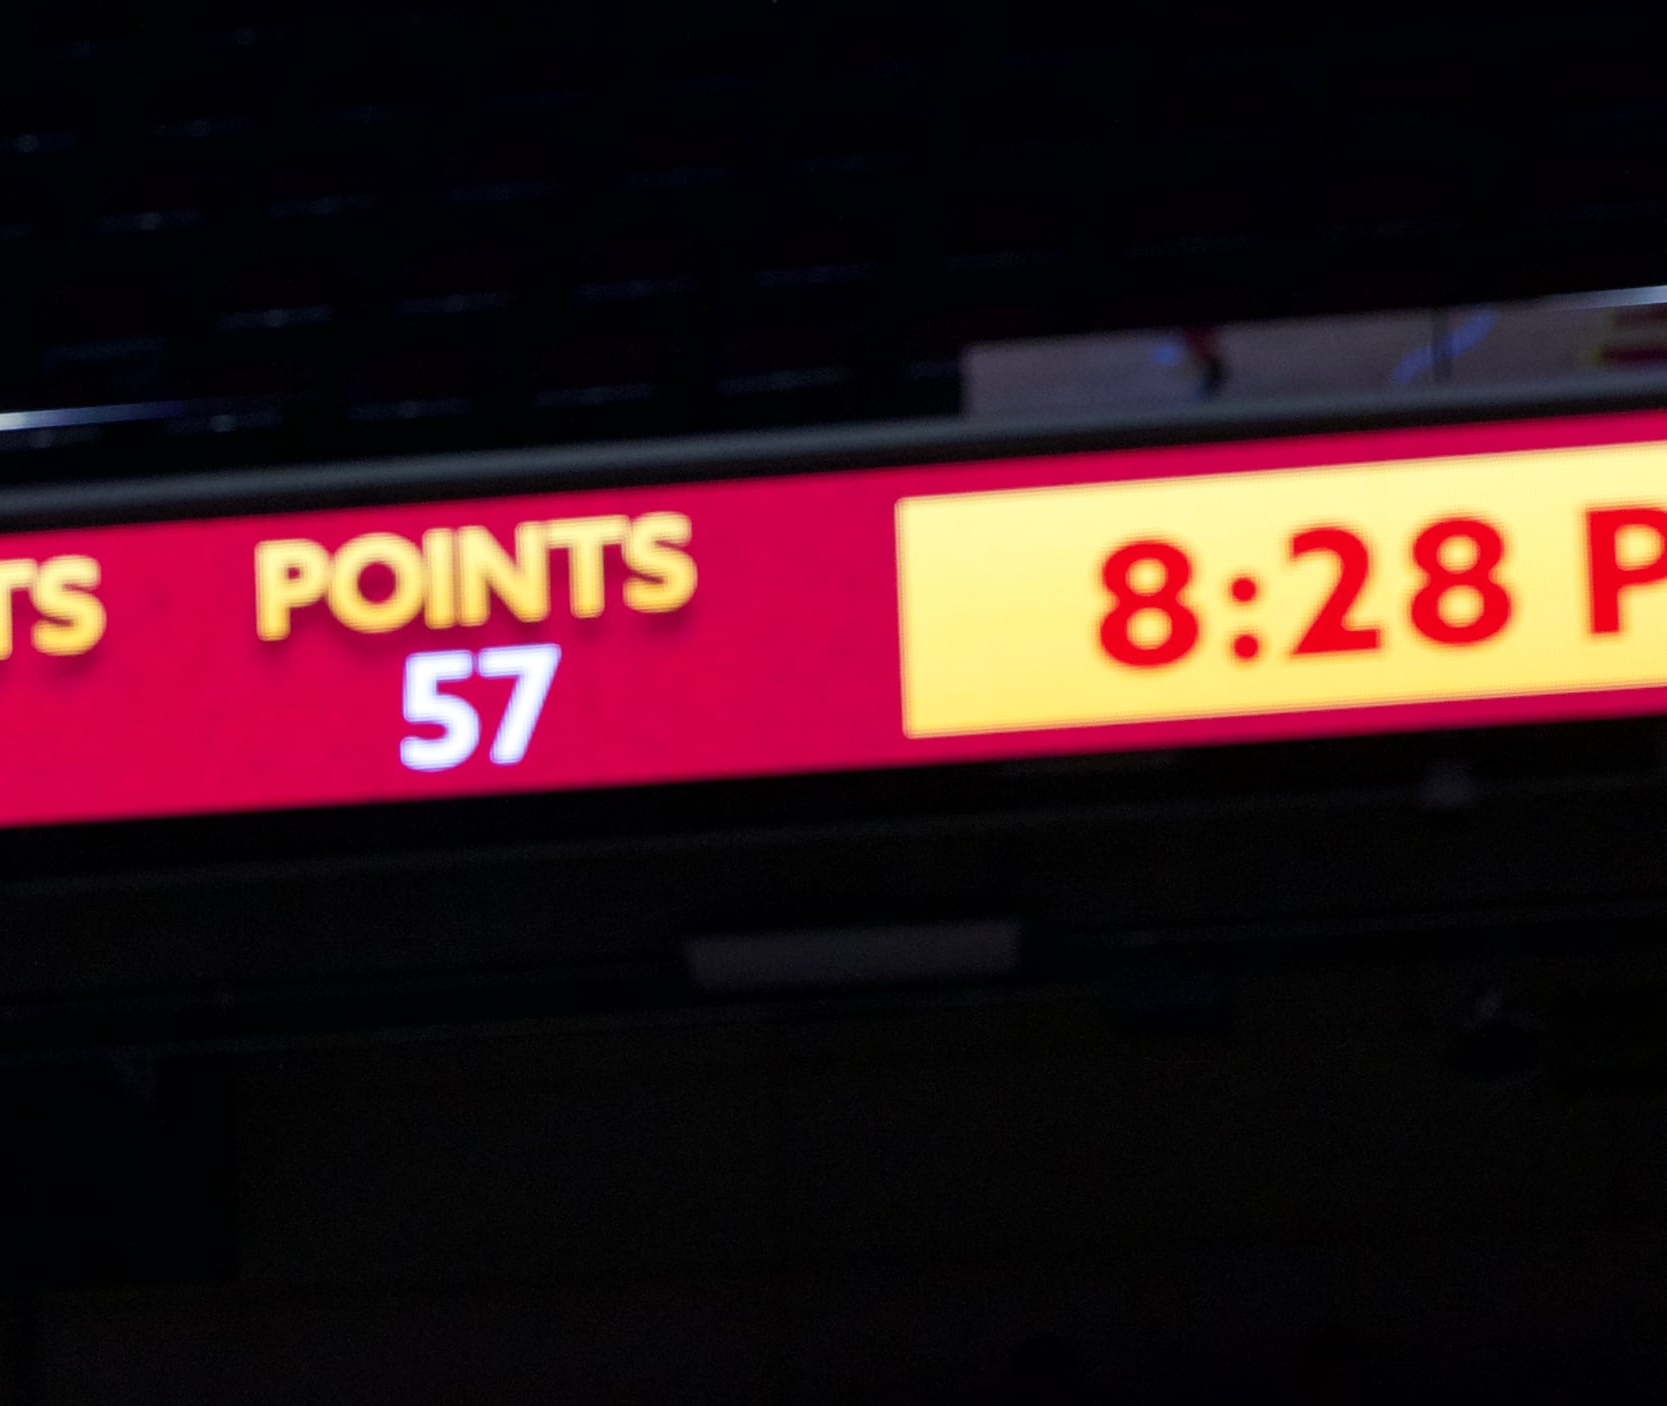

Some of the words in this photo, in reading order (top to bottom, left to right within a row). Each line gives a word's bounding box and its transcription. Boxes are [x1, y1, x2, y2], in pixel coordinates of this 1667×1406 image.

[254, 512, 696, 642] POINTS
[1096, 516, 1514, 670] 8:28
[398, 643, 560, 771] 57
